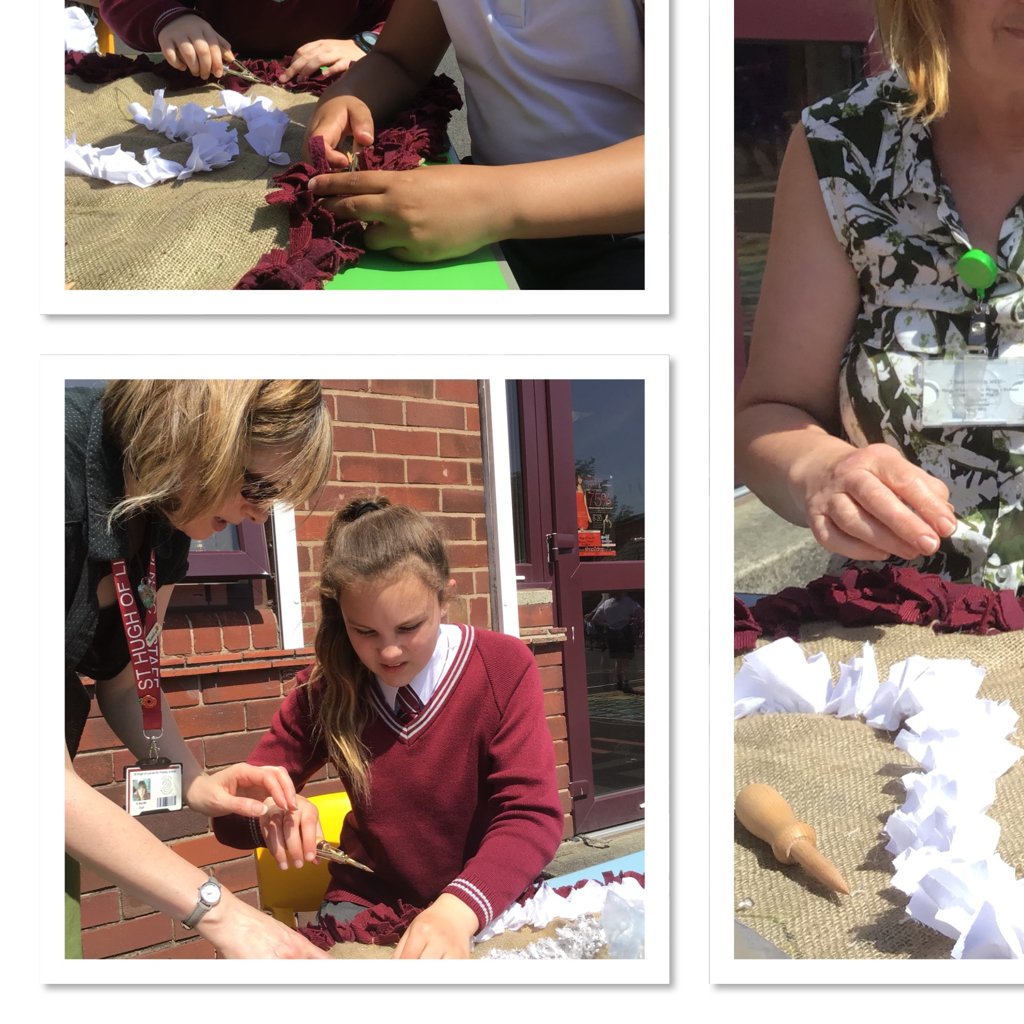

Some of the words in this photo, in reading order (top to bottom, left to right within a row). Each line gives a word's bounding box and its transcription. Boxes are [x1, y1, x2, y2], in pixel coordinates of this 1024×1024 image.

[117, 582, 134, 607] OF
[124, 611, 149, 665] HUGH
[135, 669, 154, 690] ST
